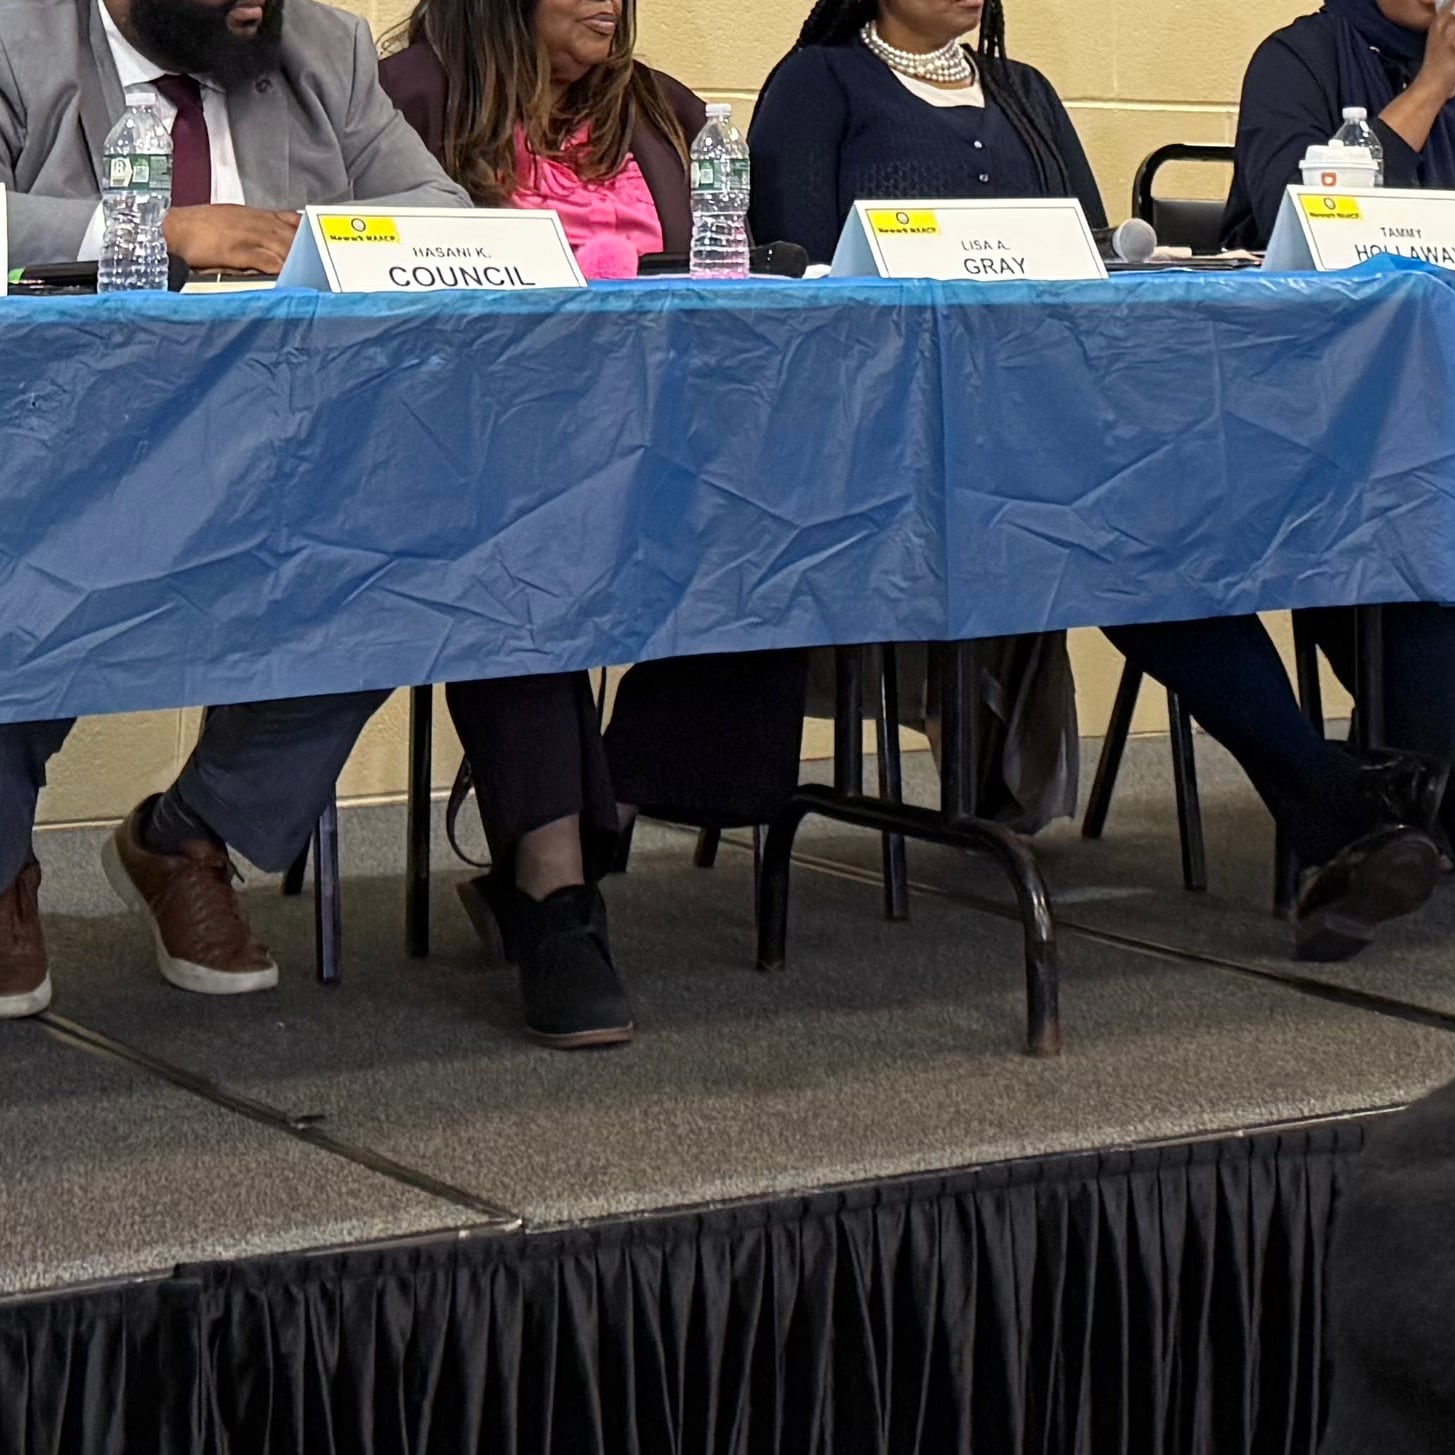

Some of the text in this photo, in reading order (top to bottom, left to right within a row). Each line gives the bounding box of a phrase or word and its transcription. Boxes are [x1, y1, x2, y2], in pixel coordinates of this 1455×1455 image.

[1379, 226, 1422, 239] TAMMY
[961, 239, 993, 251] LISA
[412, 247, 492, 259] HASANI K.
[964, 256, 1025, 275] GRAY
[388, 266, 536, 287] COUNCIL
